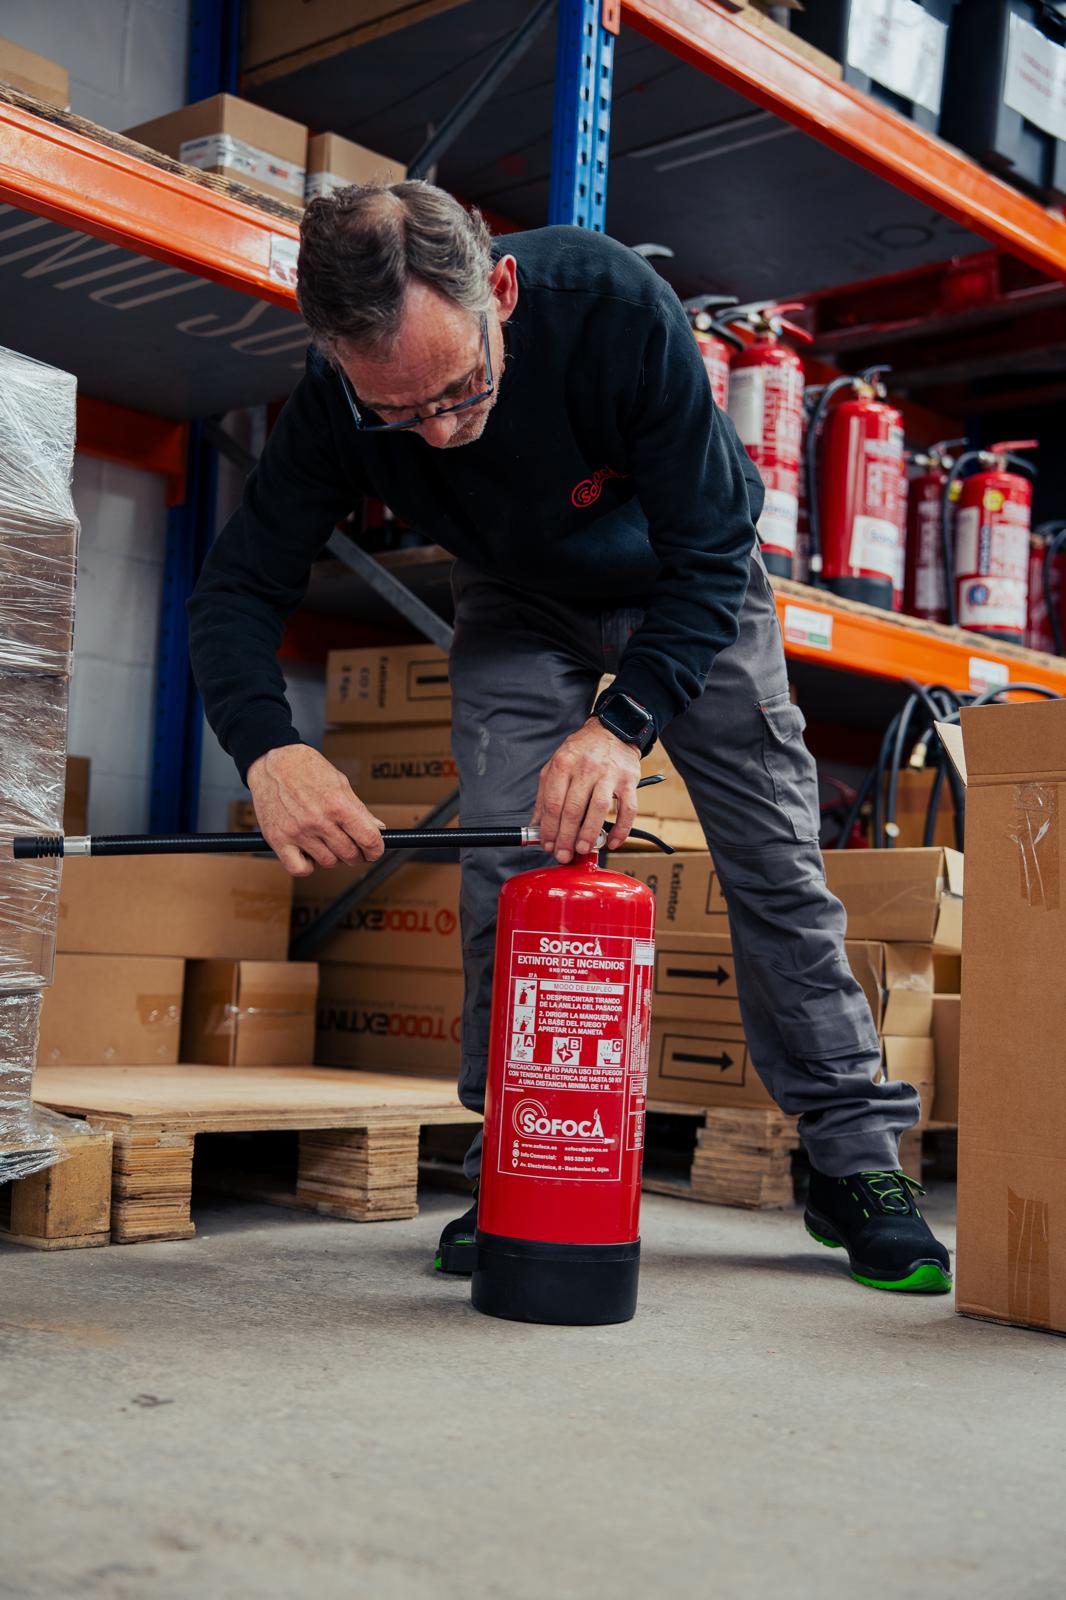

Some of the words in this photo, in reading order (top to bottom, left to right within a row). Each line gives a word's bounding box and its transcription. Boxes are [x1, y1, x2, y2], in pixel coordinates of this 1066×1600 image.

[667, 863, 683, 922] Extintor
[518, 955, 559, 967] EXTINTOR
[562, 958, 574, 968] DE
[577, 959, 624, 970] INCENDIOS
[546, 994, 594, 1003] DESPRECINTAR
[525, 1037, 533, 1046] A
[570, 1039, 579, 1049] B
[613, 1042, 621, 1051] C
